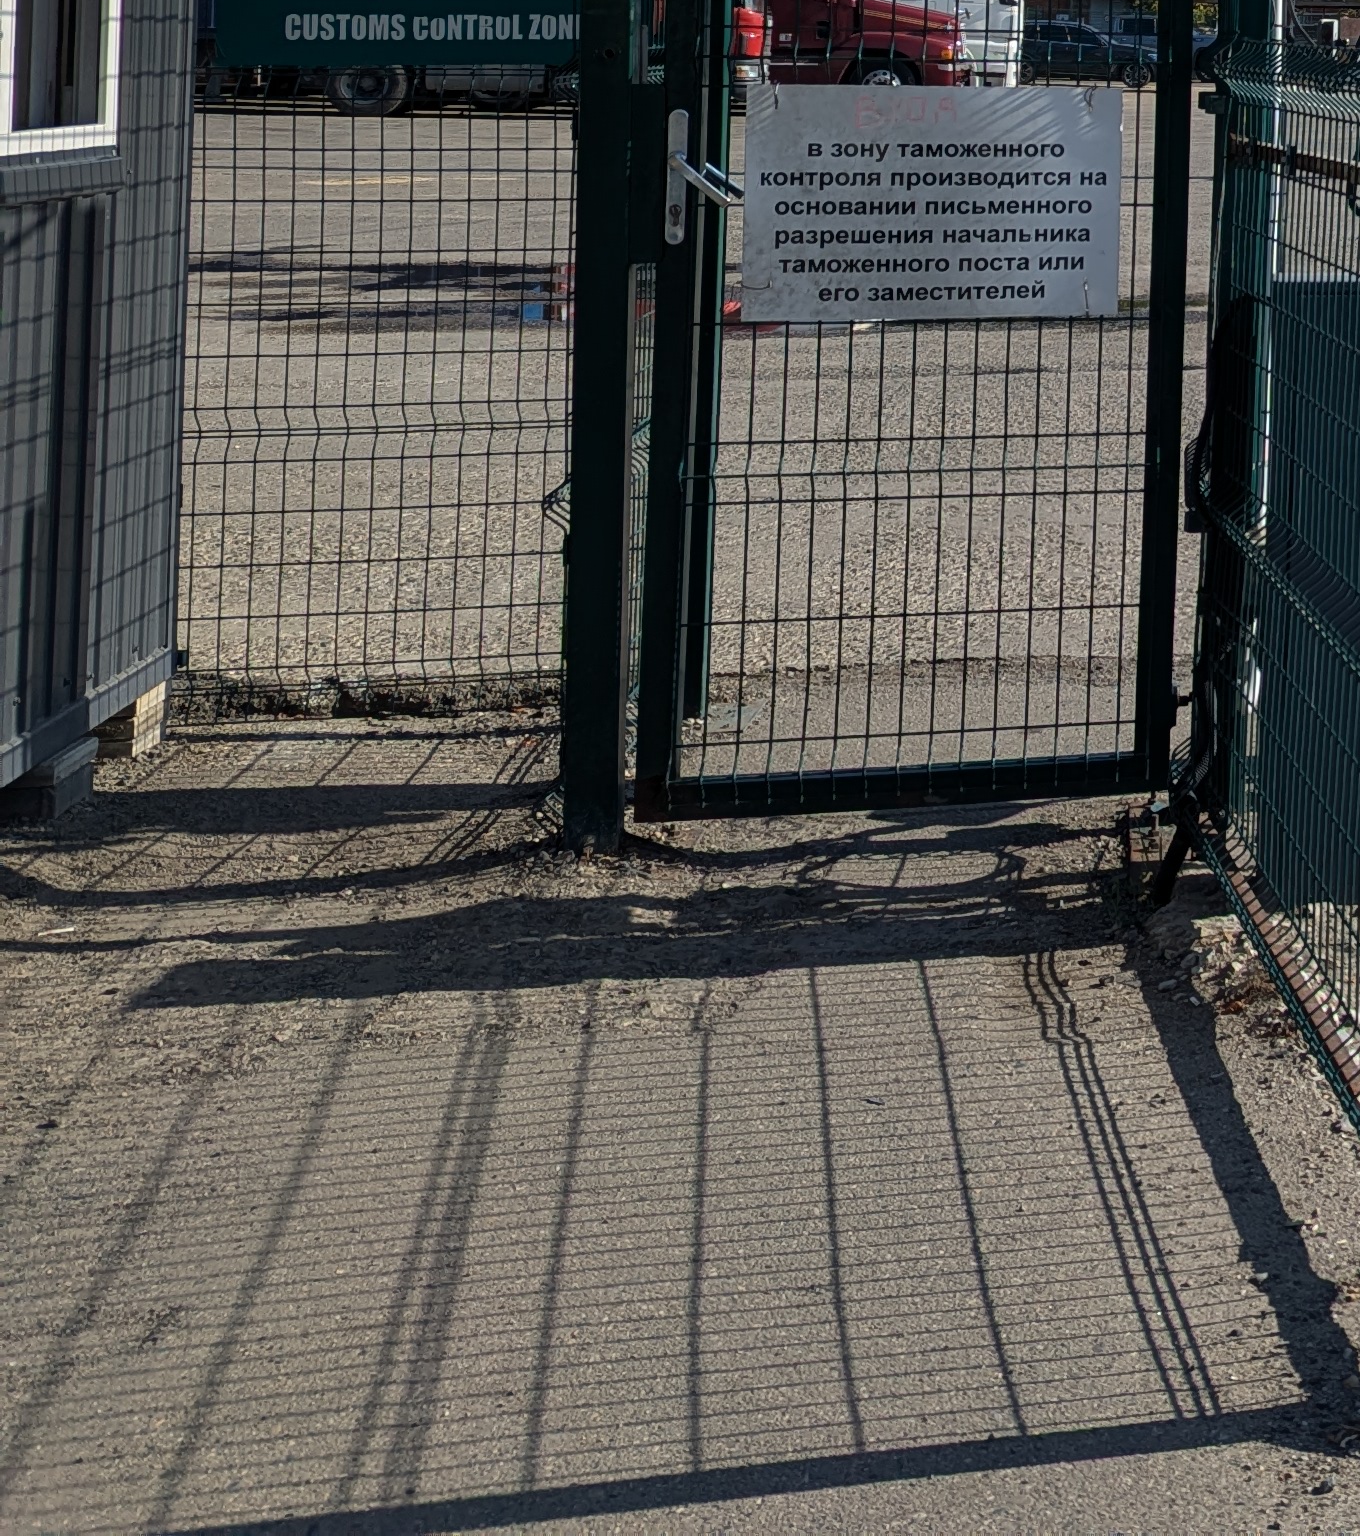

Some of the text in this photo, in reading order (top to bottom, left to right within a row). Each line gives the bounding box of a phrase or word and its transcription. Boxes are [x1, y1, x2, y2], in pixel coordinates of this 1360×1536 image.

[284, 14, 406, 41] CUSTOMS
[412, 14, 524, 41] CONTROL
[807, 142, 1065, 162] в зону таможенного
[760, 170, 1107, 191] контроля производится на
[774, 198, 1093, 215] основании письменного
[774, 226, 1091, 249] разрешения начальника
[779, 255, 1085, 274] таможенного поста или
[818, 279, 1046, 302] его заместителей
